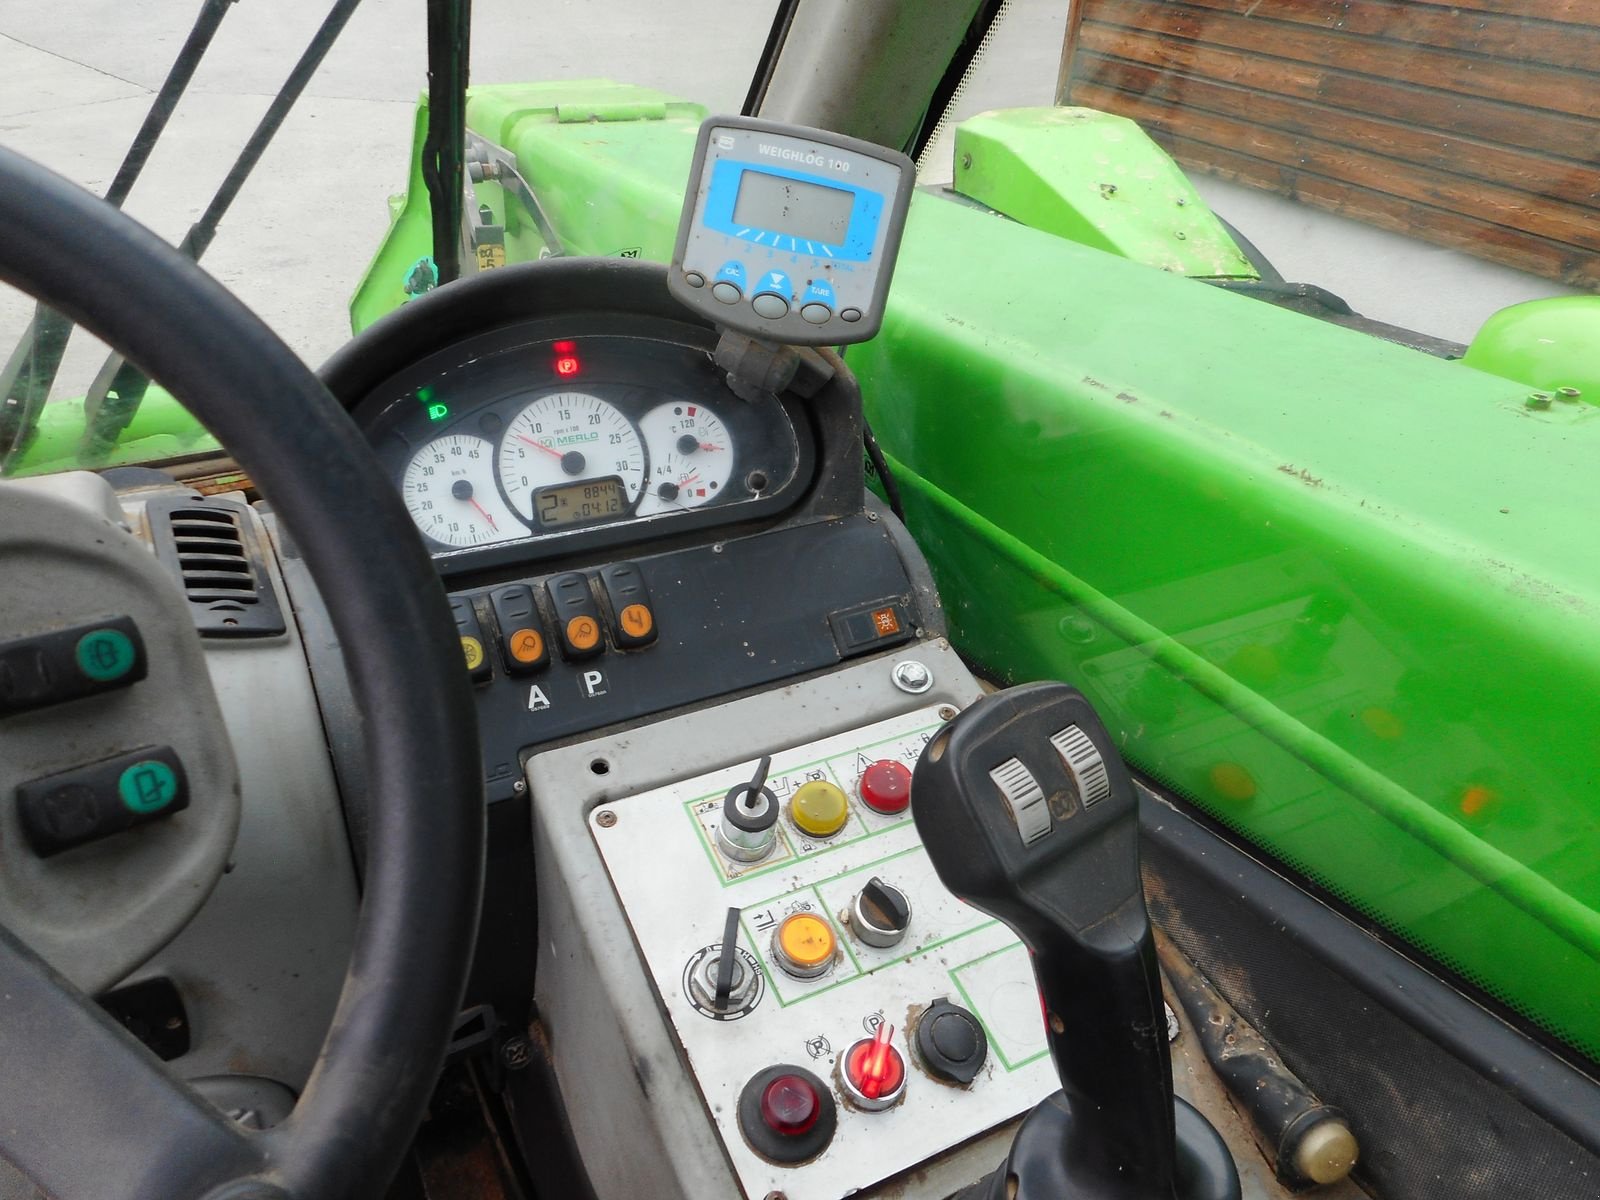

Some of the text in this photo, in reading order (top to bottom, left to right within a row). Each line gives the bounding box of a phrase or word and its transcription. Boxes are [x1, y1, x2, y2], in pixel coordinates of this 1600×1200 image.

[759, 143, 851, 173] WEIGHLOG 100
[811, 286, 831, 298] TARE
[559, 410, 571, 421] 15
[588, 413, 601, 425] 20
[530, 422, 542, 433] 10
[680, 418, 695, 429] 120
[557, 431, 599, 444] MERLO
[609, 433, 622, 445] 25
[451, 447, 462, 456] 40
[469, 450, 479, 459] 45
[518, 448, 525, 458] 5
[434, 454, 445, 463] 35
[423, 466, 434, 476] 30
[616, 460, 629, 472] 30
[656, 465, 672, 476] 4/4
[521, 476, 528, 487] 0
[417, 483, 429, 493] 25
[584, 484, 615, 499] 8844
[687, 488, 693, 498] 0
[422, 501, 433, 510] 20
[541, 494, 558, 521] 2
[433, 514, 443, 524] 15
[449, 523, 459, 532] 10
[470, 524, 475, 533] 5
[583, 670, 603, 695] P
[528, 684, 551, 709] A
